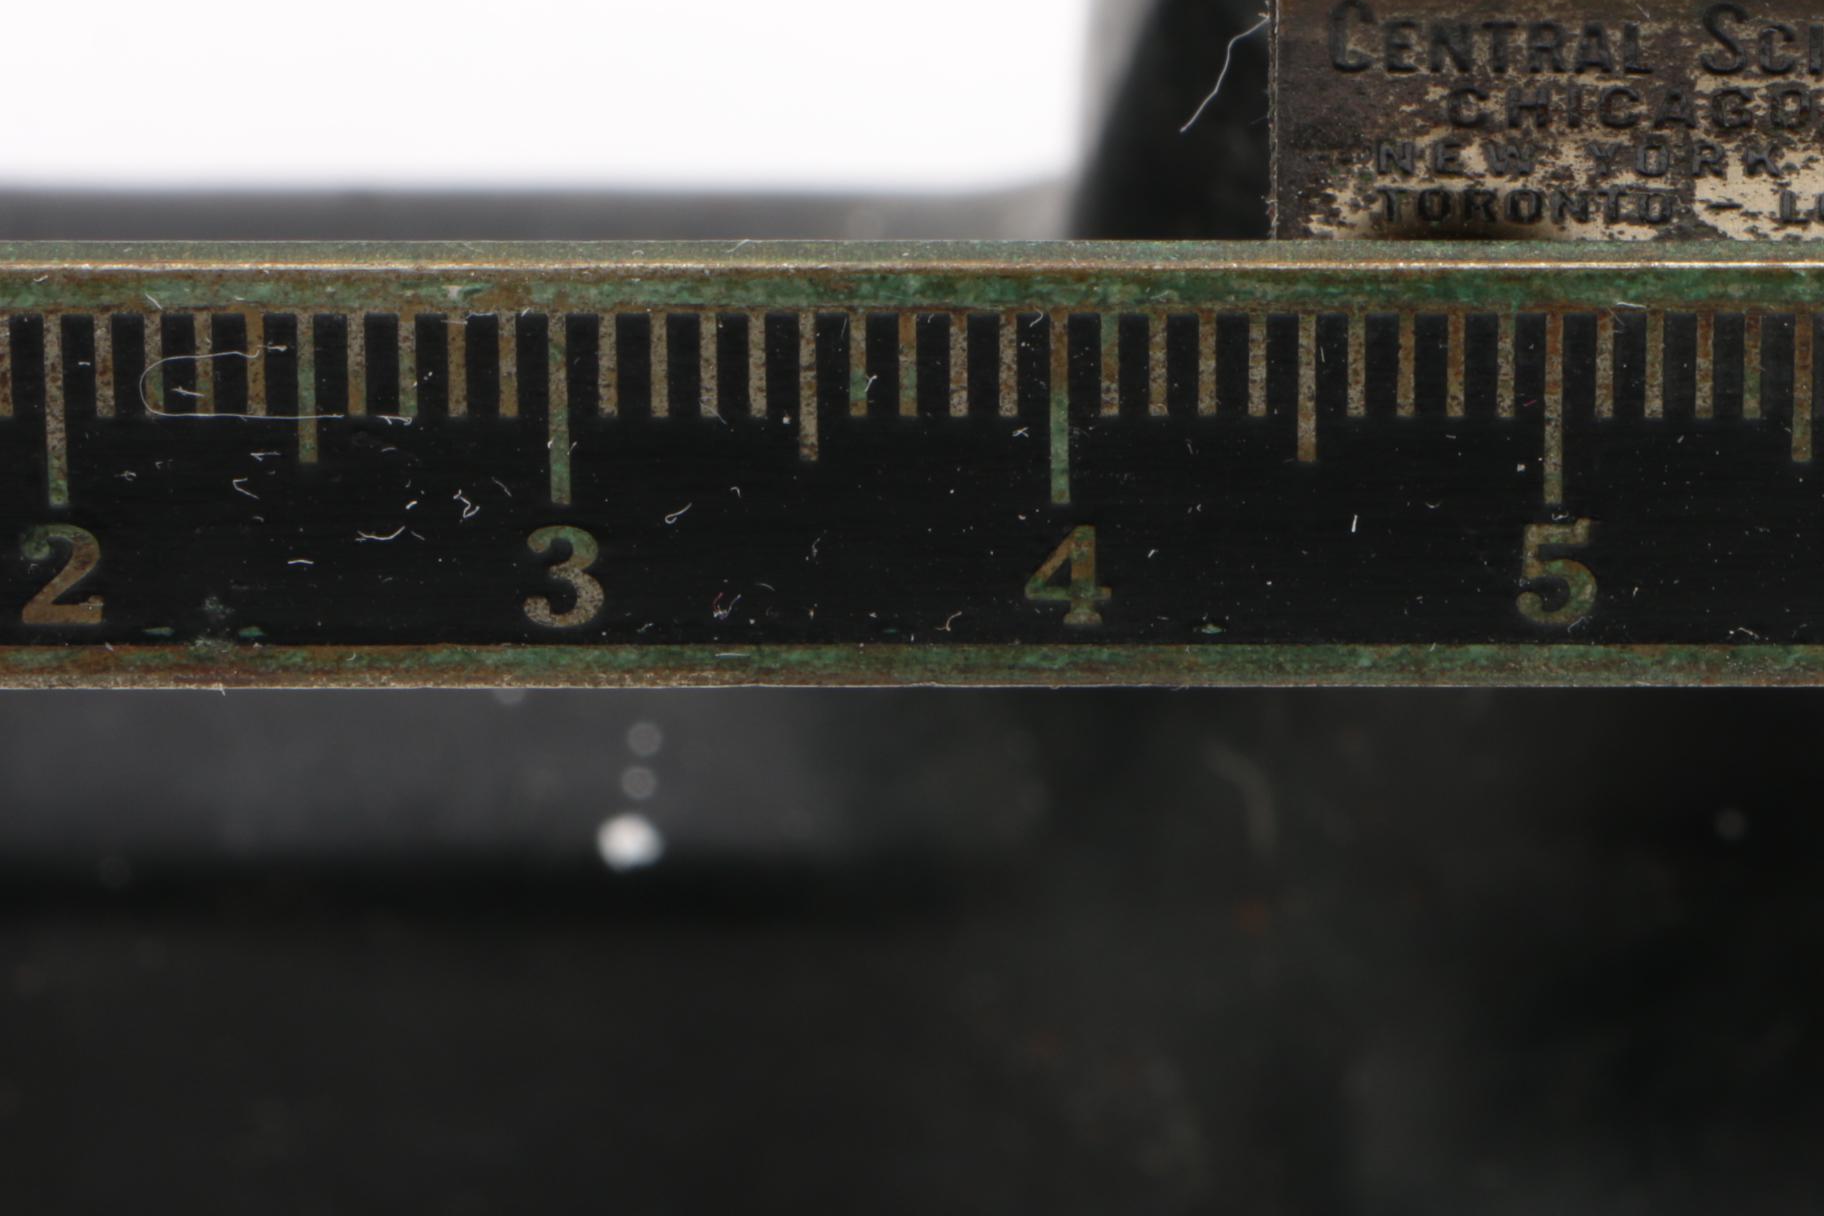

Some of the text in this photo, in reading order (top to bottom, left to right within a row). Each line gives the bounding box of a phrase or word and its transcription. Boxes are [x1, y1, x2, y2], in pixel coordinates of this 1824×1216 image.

[1377, 138, 1537, 178] NEW
[1587, 138, 1786, 180] YORK
[1377, 186, 1676, 226] TORONTO
[20, 523, 104, 625] 2
[522, 525, 604, 629] 3
[1024, 524, 1112, 626] 4
[1515, 517, 1598, 625] 5
